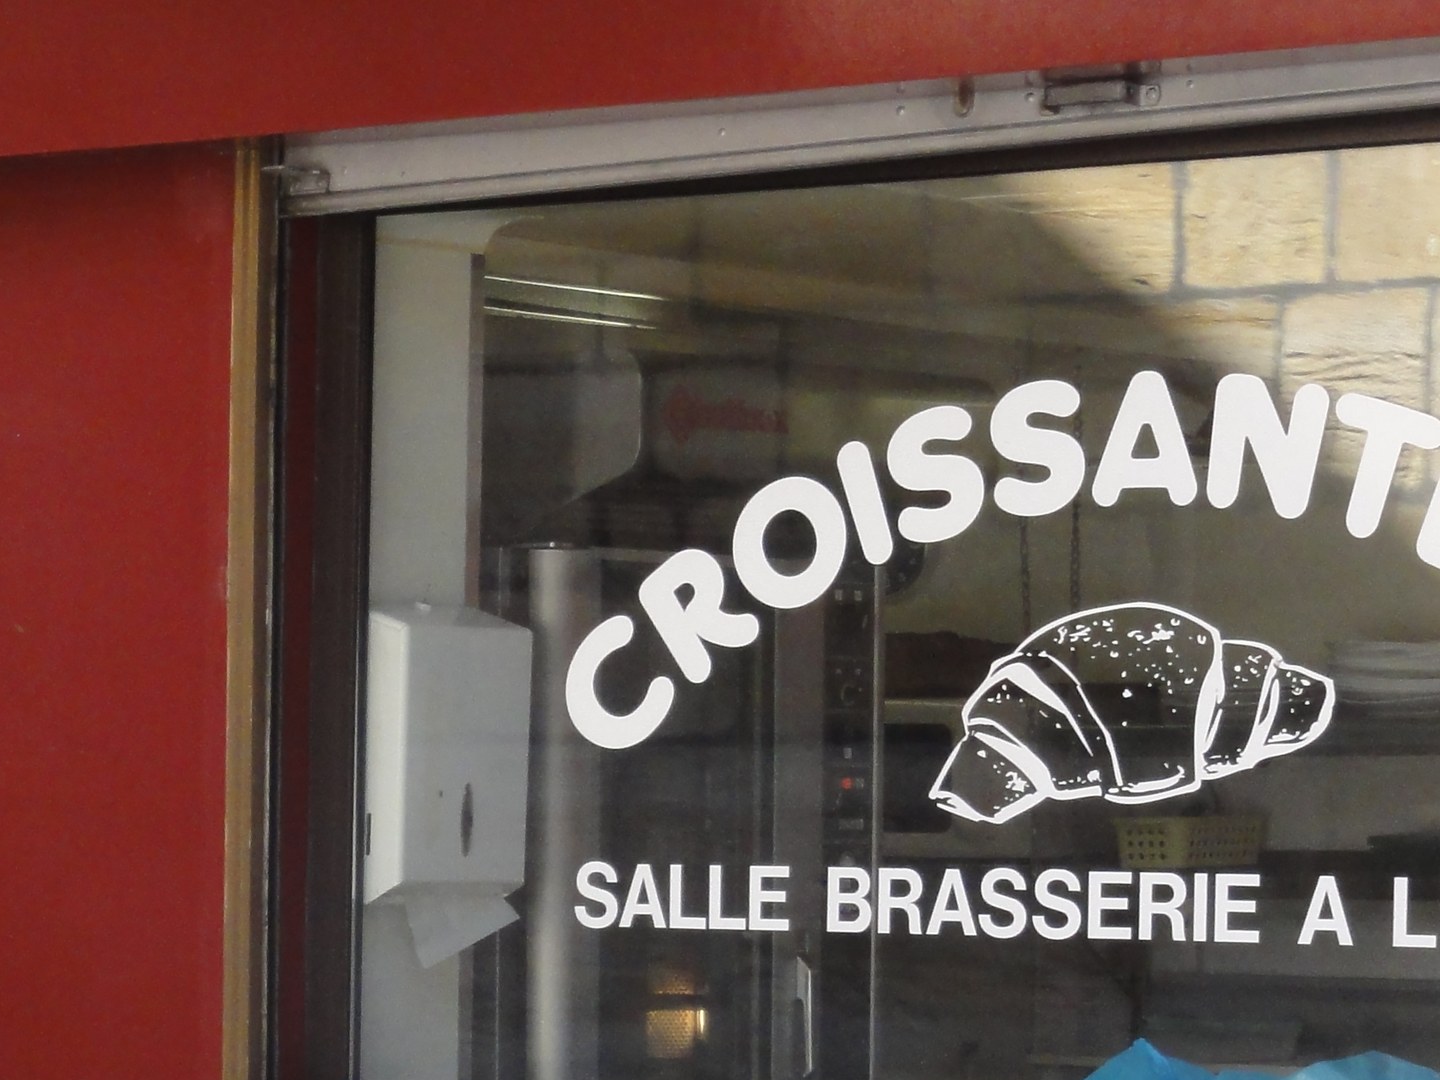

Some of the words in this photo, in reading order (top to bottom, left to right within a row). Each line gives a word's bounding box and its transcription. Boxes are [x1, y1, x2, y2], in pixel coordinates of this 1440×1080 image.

[566, 370, 1440, 749] CROISSANT
[574, 861, 790, 930] SALLE
[826, 866, 1261, 942] BRASSERIE
[1297, 875, 1354, 946] A
